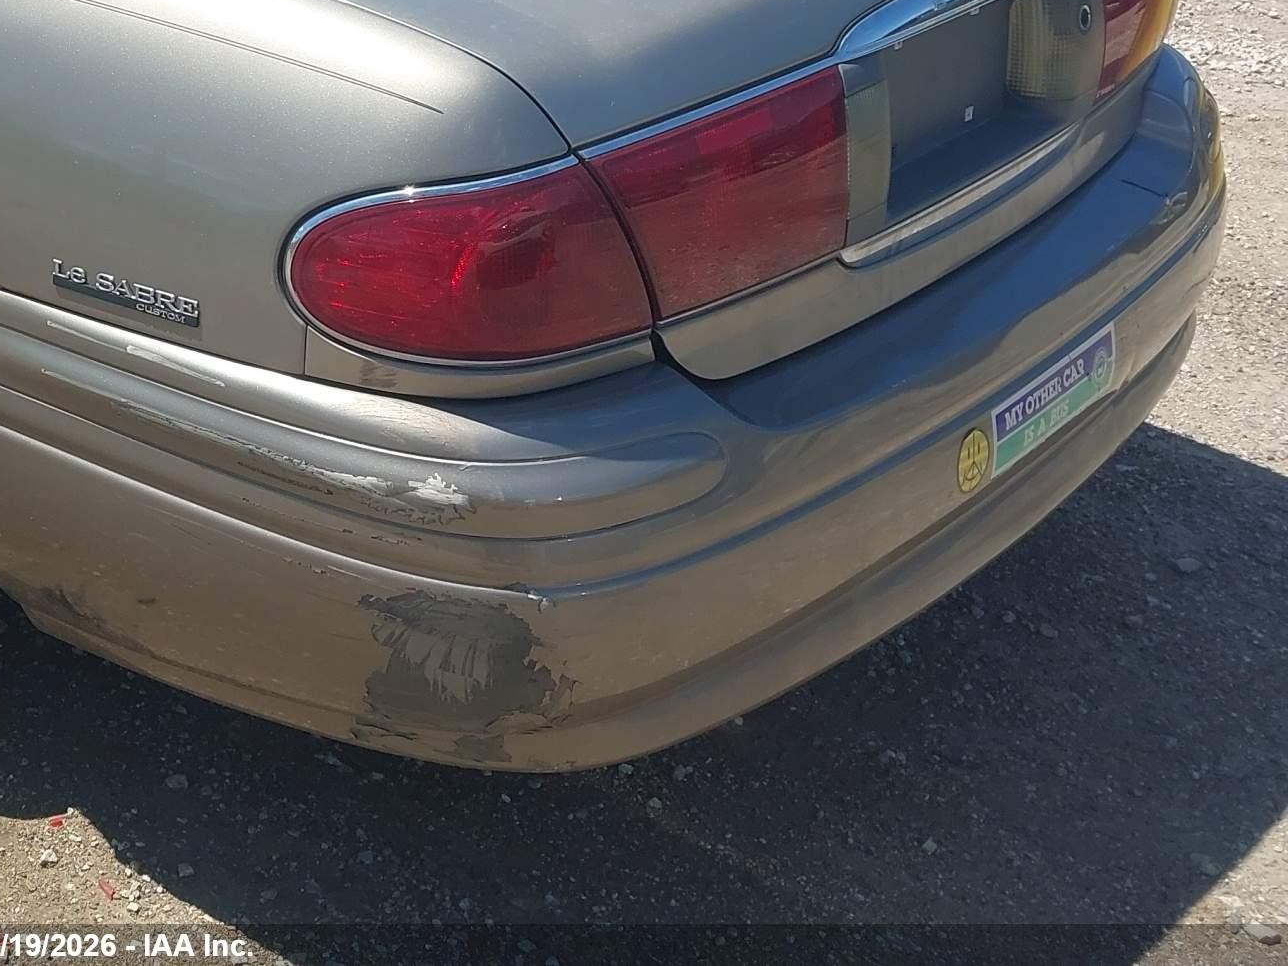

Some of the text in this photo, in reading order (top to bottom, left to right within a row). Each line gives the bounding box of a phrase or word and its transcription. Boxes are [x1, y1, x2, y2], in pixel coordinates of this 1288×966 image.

[52, 258, 200, 317] Le SABRE
[136, 303, 187, 324] CUSTOM
[1005, 401, 1025, 431] MY
[1025, 377, 1063, 415] OTHER
[1063, 359, 1085, 388] CAR
[1023, 399, 1070, 445] IS A BUS
